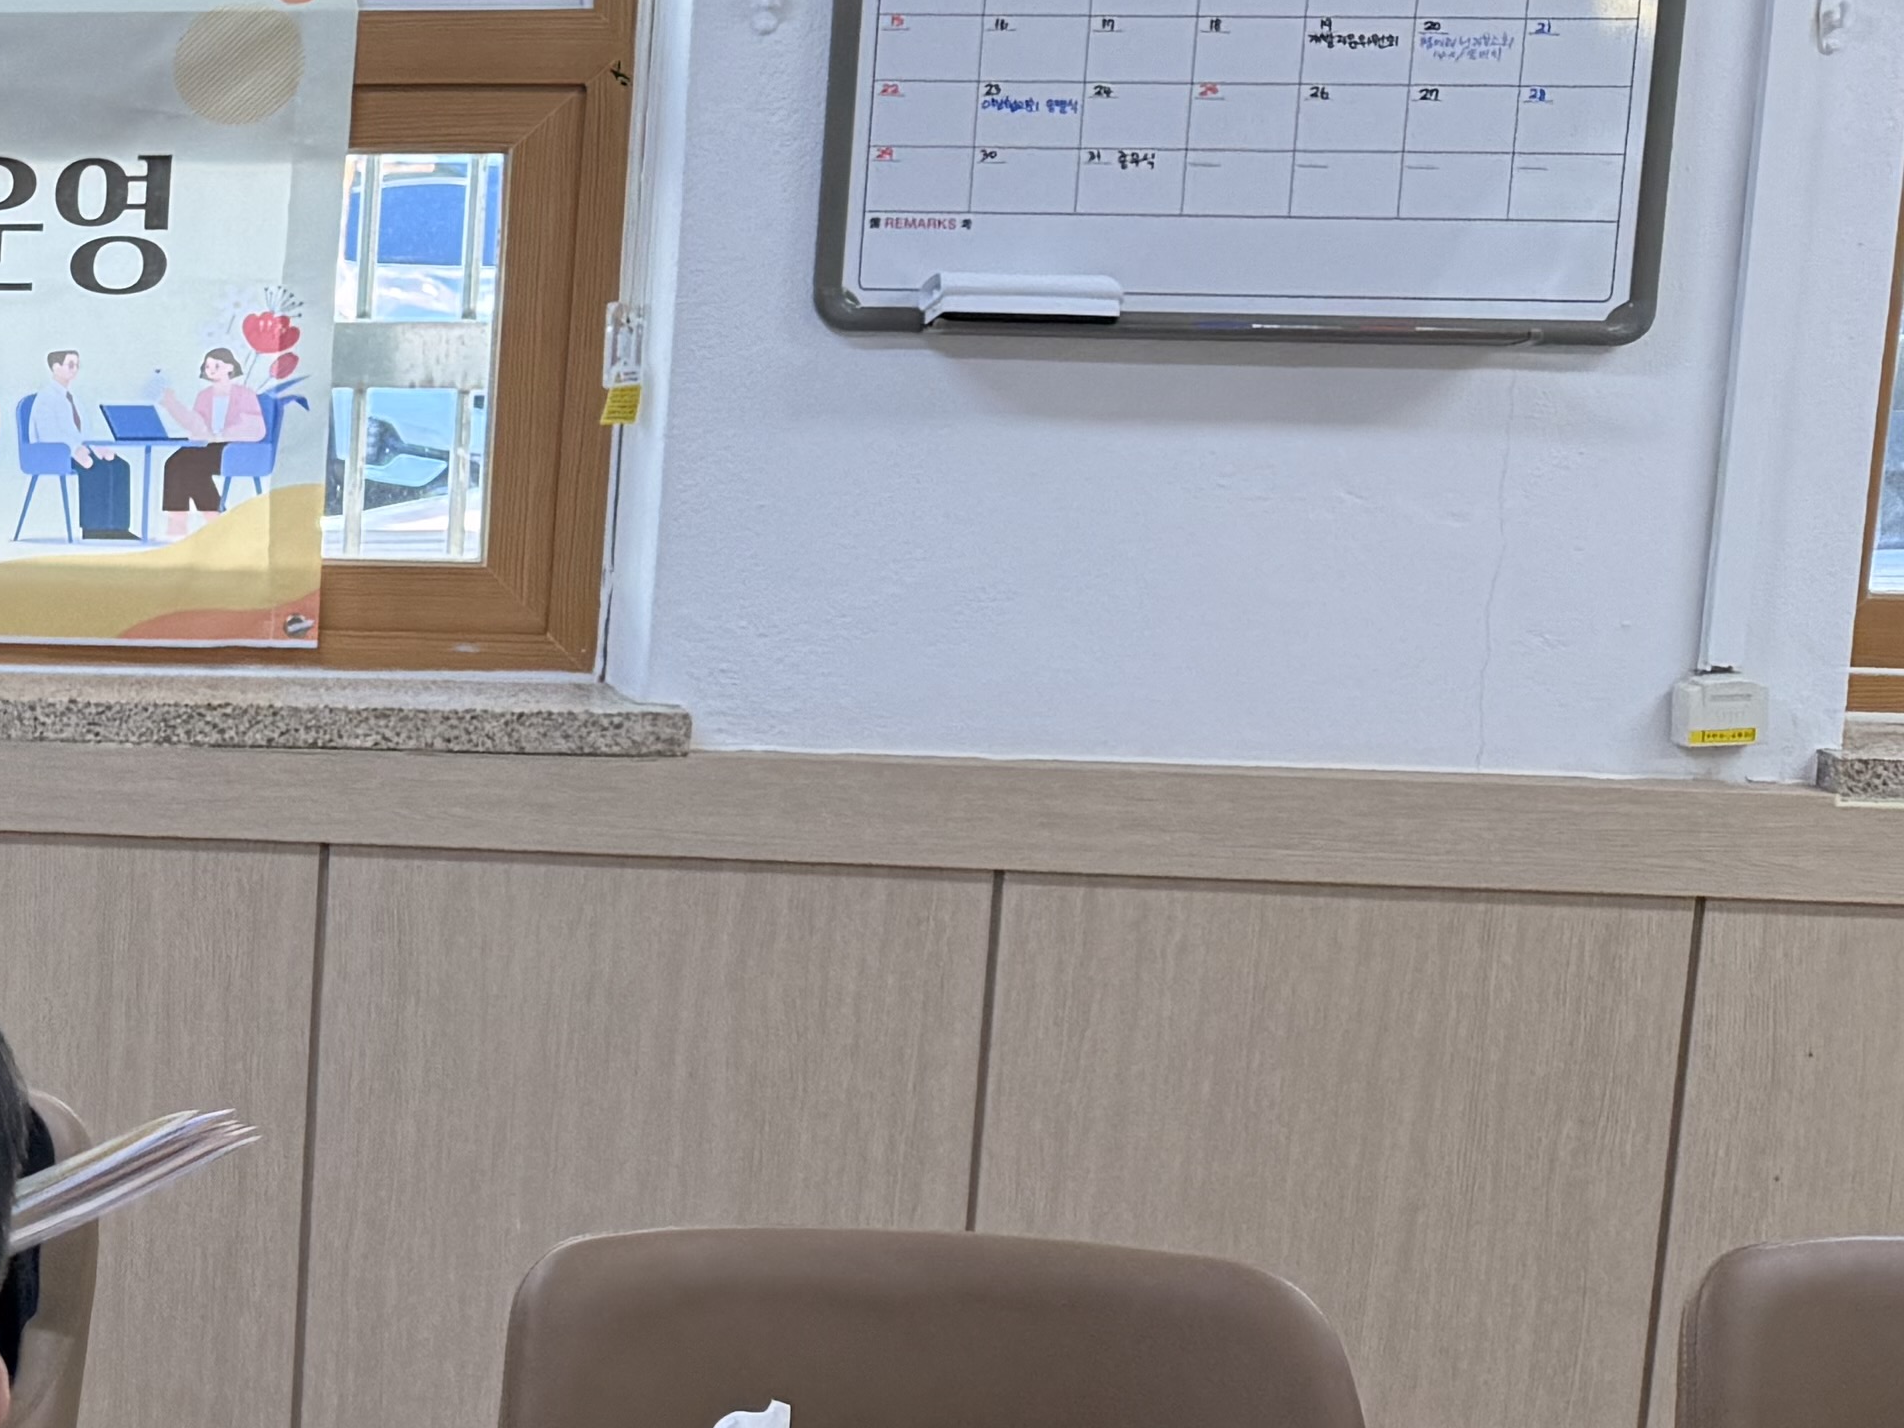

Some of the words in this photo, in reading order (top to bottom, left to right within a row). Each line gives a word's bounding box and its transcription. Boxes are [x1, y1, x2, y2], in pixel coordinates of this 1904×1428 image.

[1320, 17, 1332, 31] 19
[1423, 21, 1441, 31] 20
[984, 83, 1001, 97] 23
[1094, 85, 1113, 97] 24
[1309, 86, 1330, 100] 26
[1419, 88, 1440, 100] 27
[979, 149, 998, 161] 30
[1088, 150, 1101, 161] 31
[884, 217, 957, 230] REMARKS
